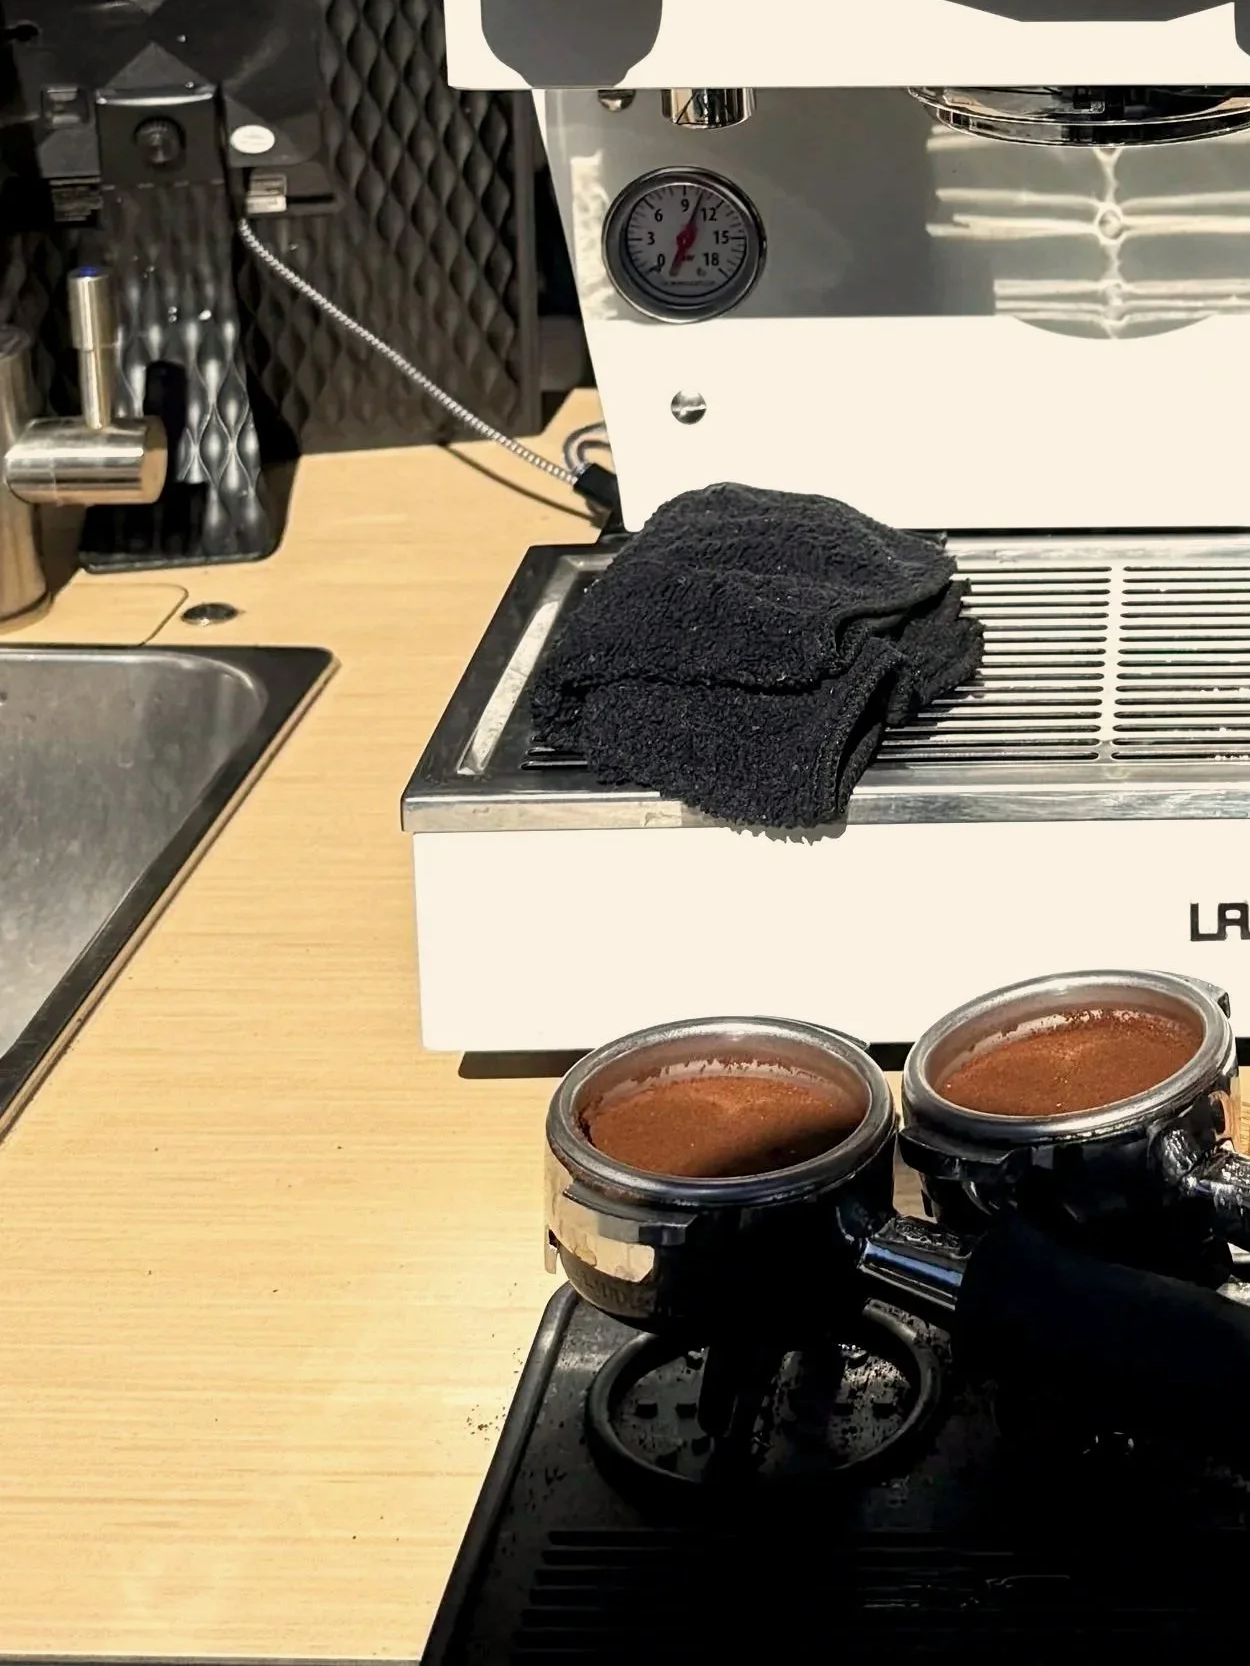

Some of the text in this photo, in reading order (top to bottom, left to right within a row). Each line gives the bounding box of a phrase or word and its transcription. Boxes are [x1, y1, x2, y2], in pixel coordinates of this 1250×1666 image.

[681, 199, 690, 212] 9
[654, 209, 663, 222] 6
[702, 208, 717, 222] 12
[647, 232, 655, 245] 3
[714, 231, 730, 245] 15
[657, 254, 665, 267] 0
[703, 253, 719, 266] 18
